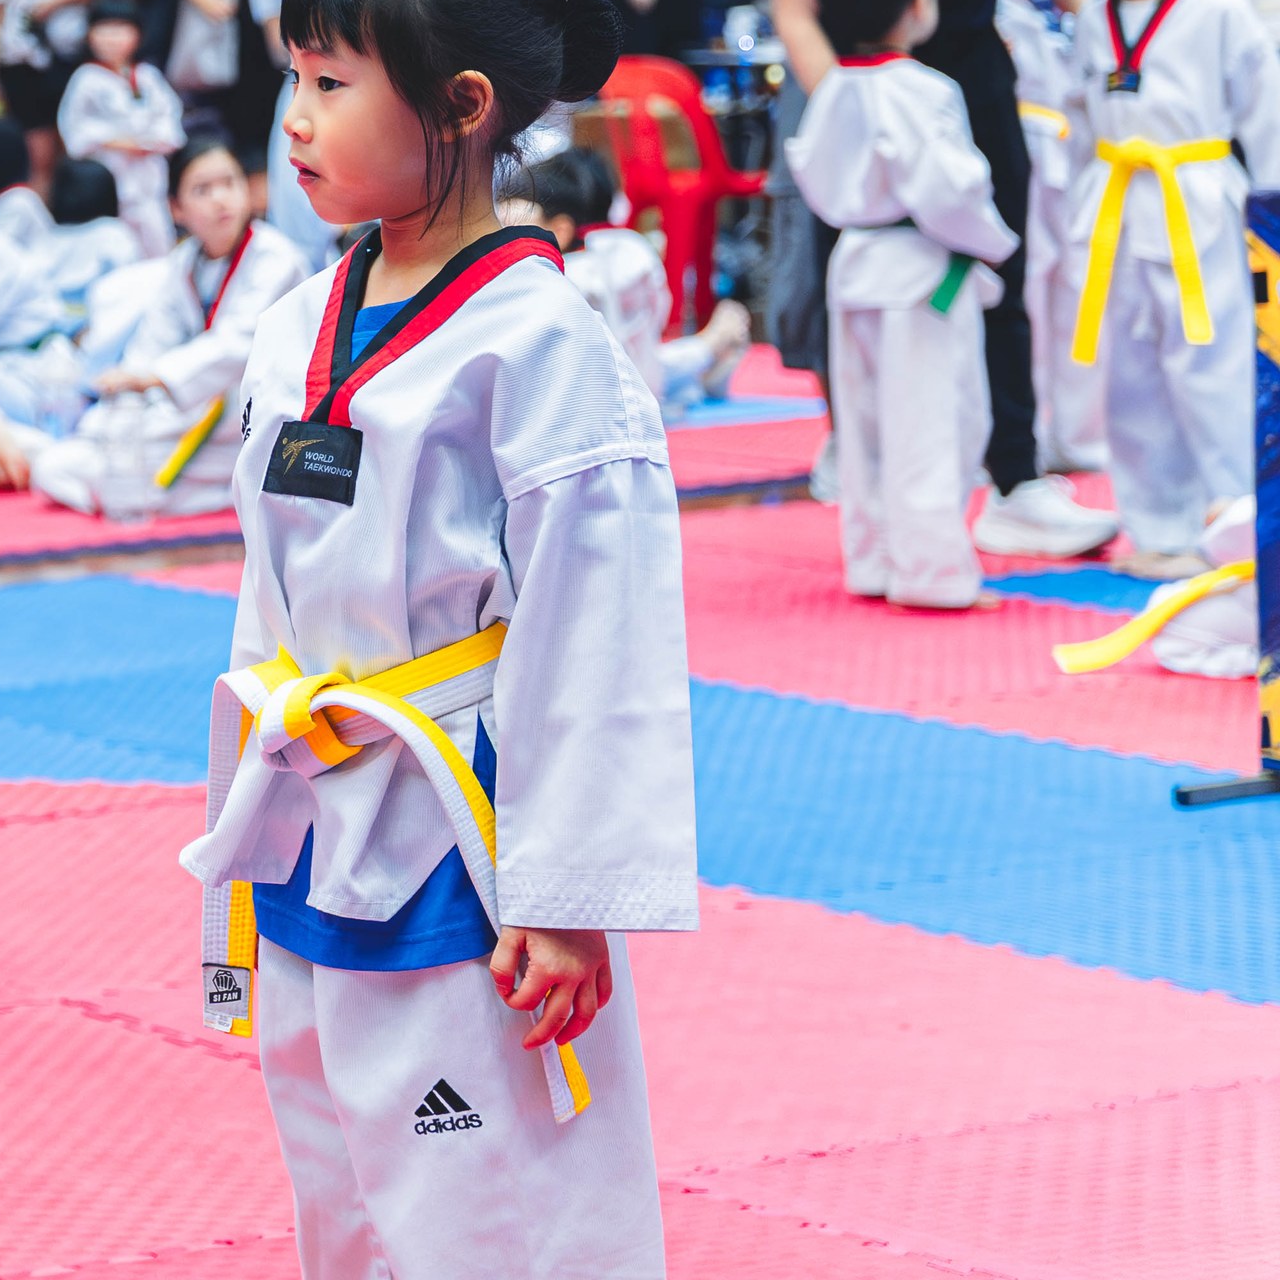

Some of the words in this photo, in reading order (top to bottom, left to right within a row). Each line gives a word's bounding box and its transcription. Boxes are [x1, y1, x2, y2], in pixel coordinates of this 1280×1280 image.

[305, 451, 335, 463] WORLD
[303, 461, 353, 478] TAEKWONDO
[212, 994, 221, 1002] SI
[222, 992, 238, 1001] FAN
